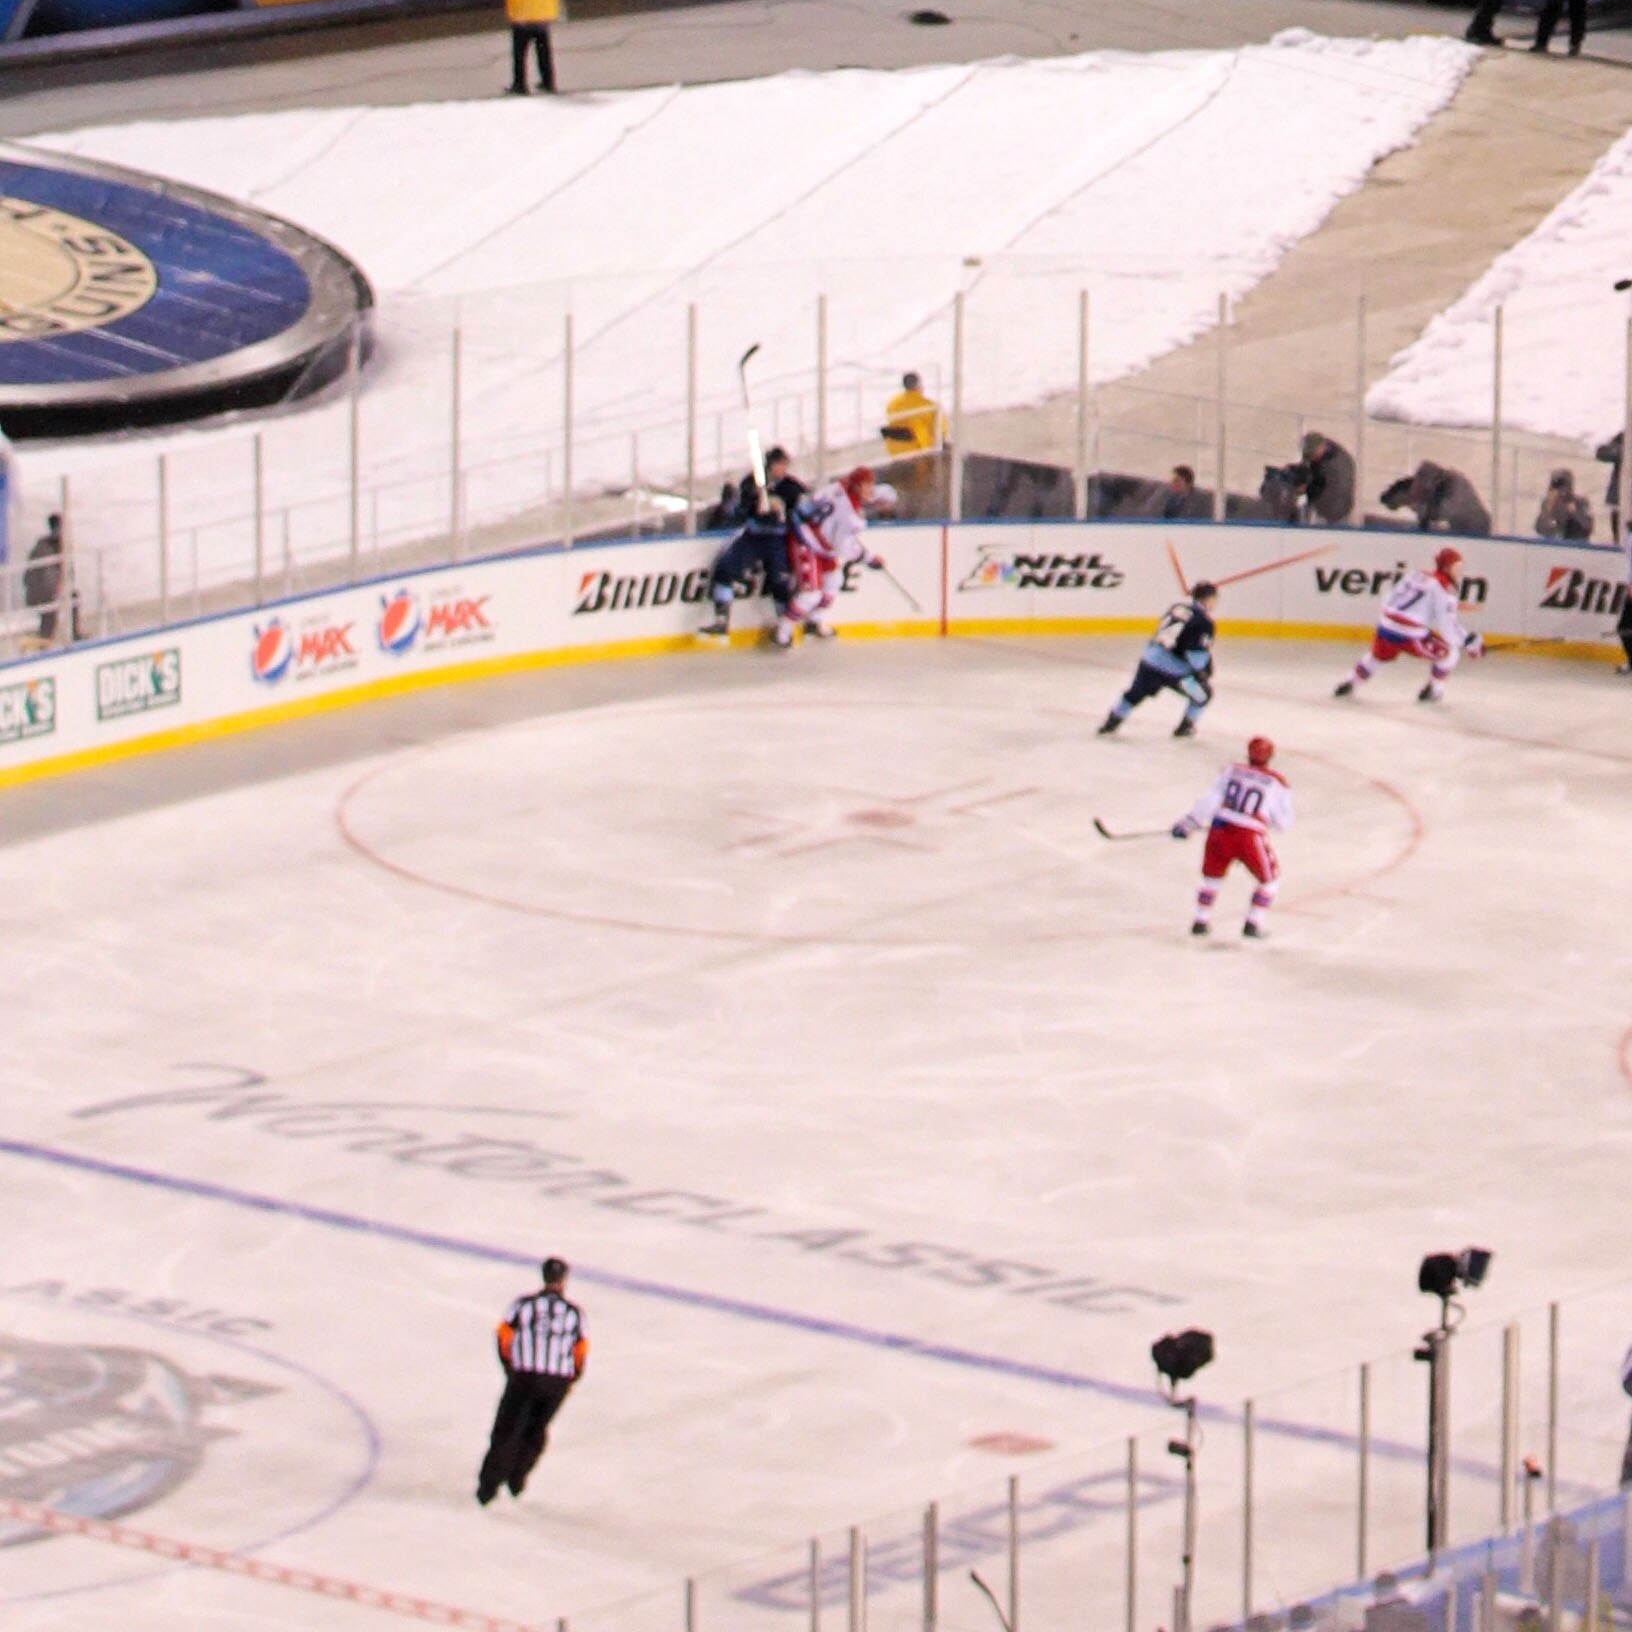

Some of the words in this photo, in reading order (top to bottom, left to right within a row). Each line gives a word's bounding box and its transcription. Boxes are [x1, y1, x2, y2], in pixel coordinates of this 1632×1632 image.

[1013, 552, 1116, 571] NHL
[1017, 571, 1126, 589] NBC
[1315, 559, 1489, 604] verin
[426, 594, 493, 637] MAX
[298, 623, 354, 664] MAX
[98, 650, 179, 708] DICK'S
[592, 1186, 1188, 1318] CLASSIC
